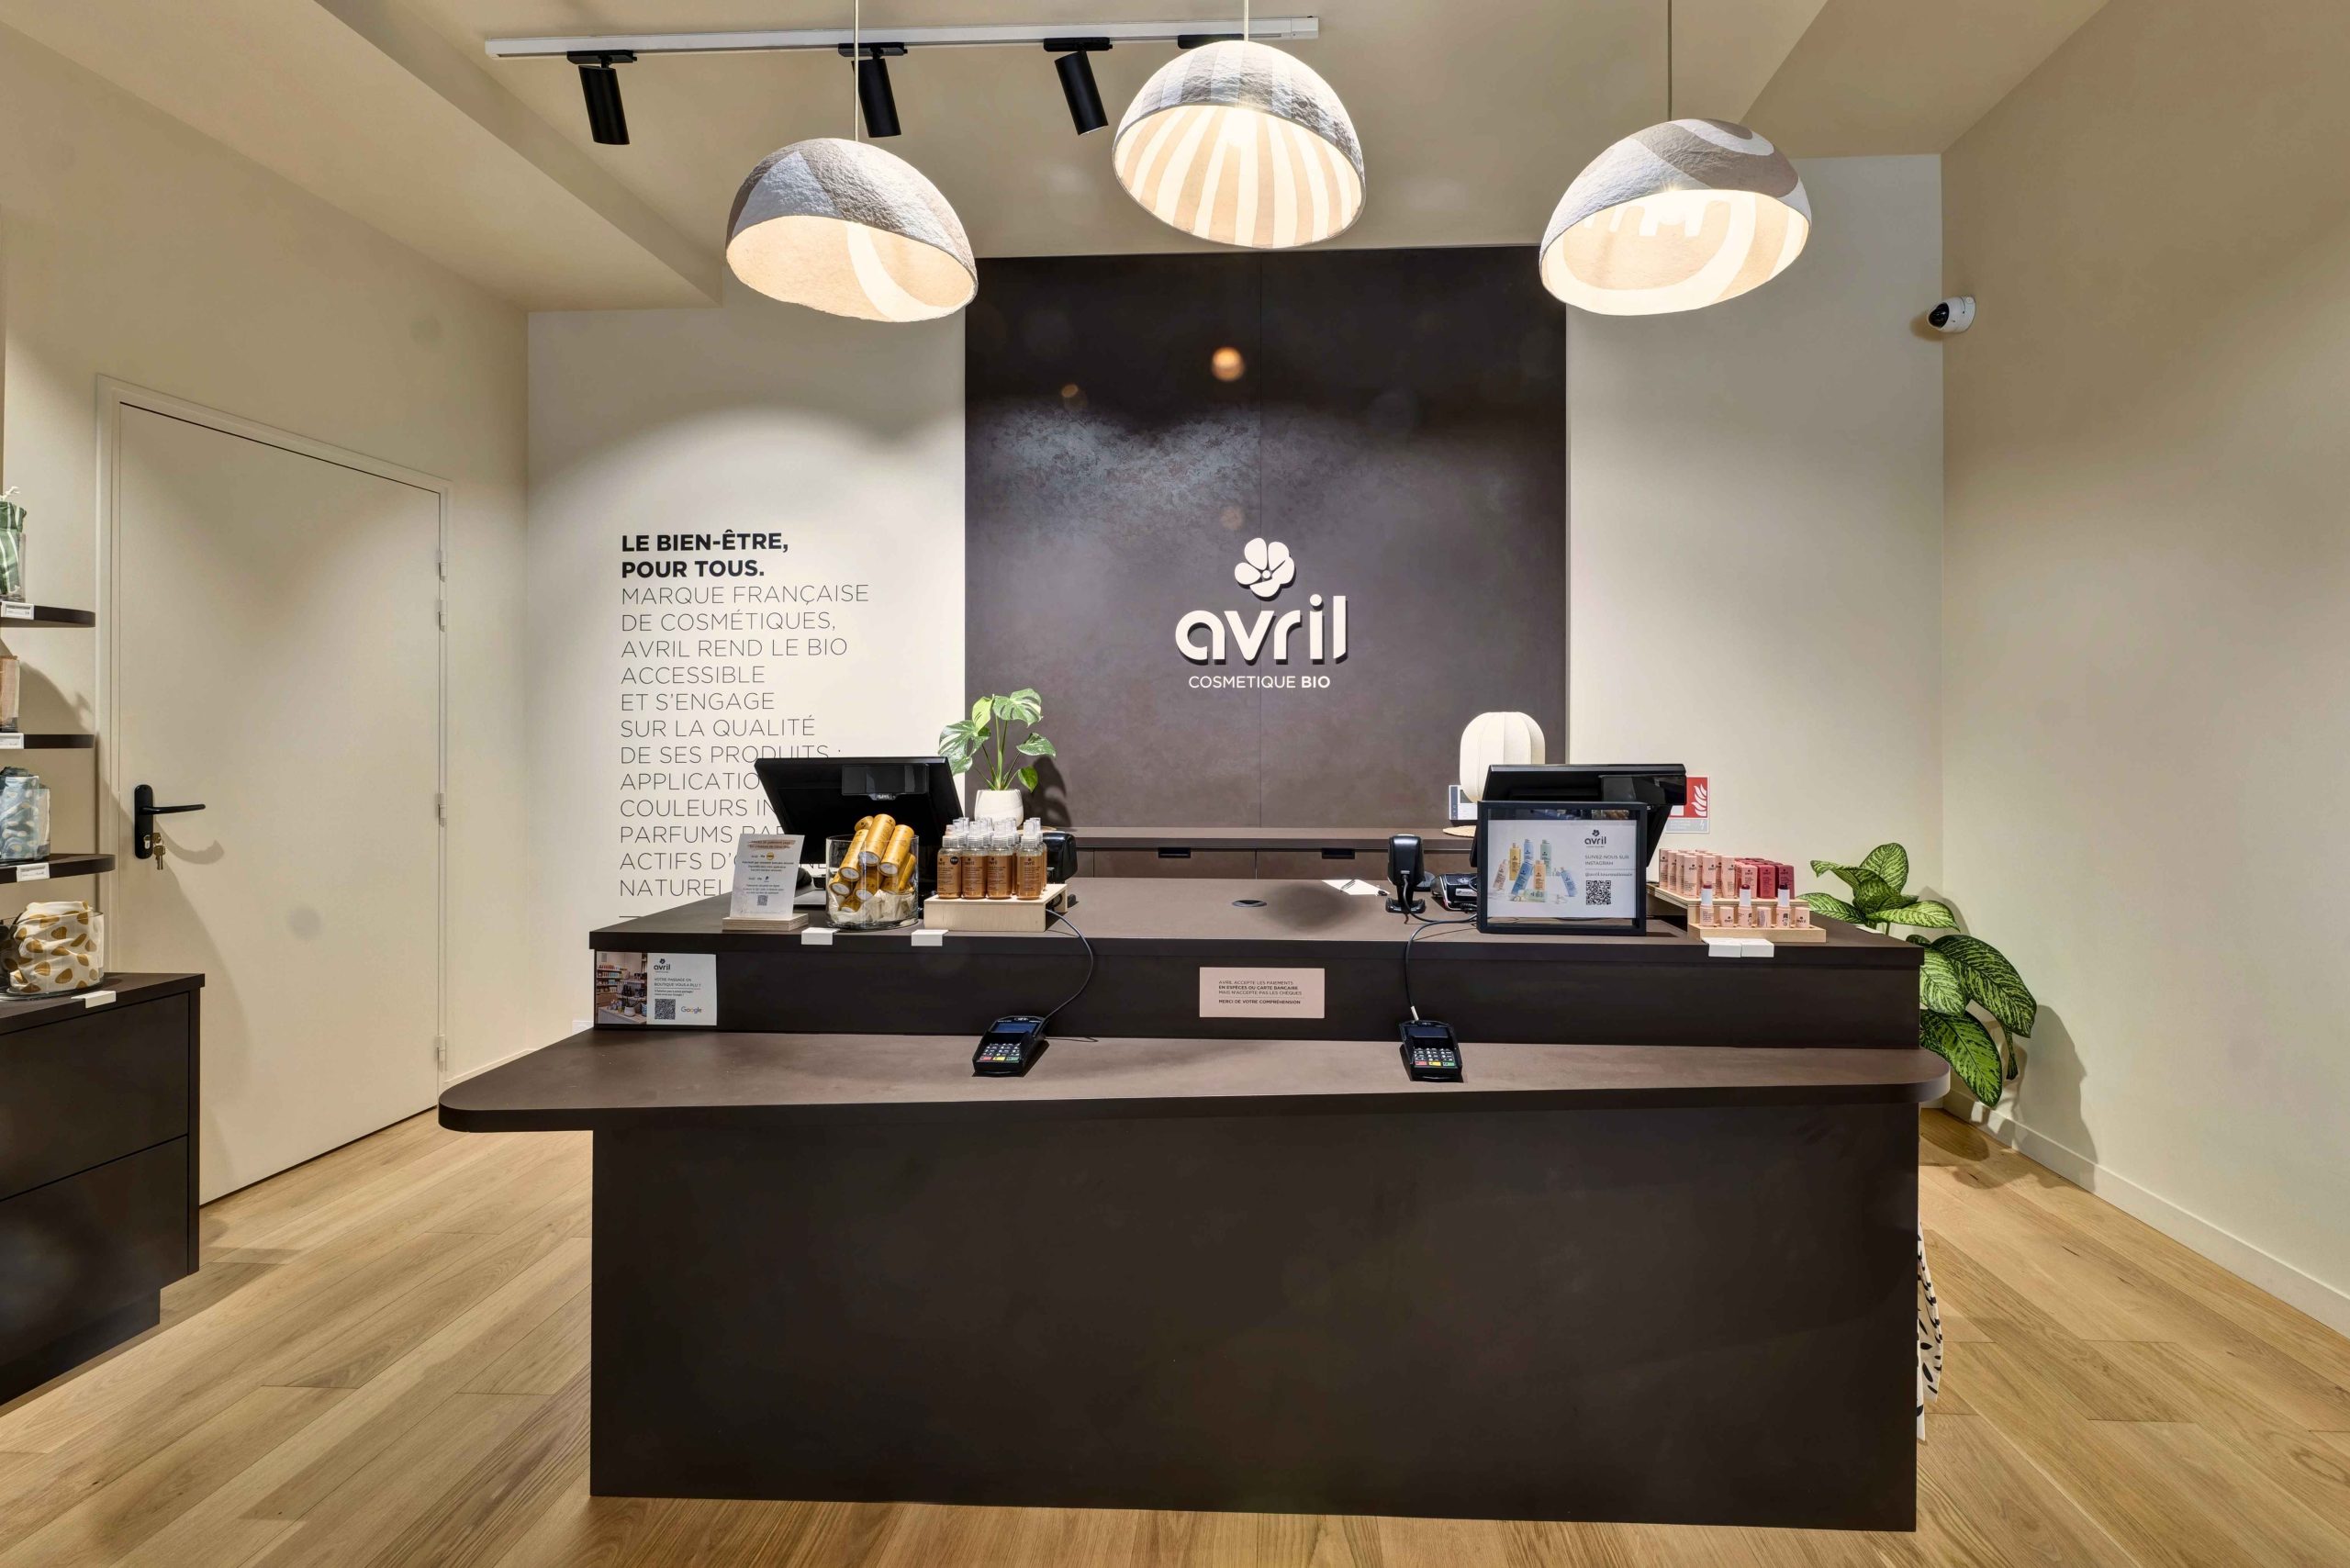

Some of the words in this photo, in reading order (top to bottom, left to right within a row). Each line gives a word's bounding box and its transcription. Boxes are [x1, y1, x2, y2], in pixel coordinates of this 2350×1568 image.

[621, 534, 650, 552] LE
[656, 529, 789, 553] BIEN-ÊTRE,
[621, 561, 688, 578] POUR
[695, 559, 765, 577] TOUS.
[621, 587, 725, 605] MARQUE
[733, 584, 869, 606] FRANÇAISE
[621, 613, 652, 632] DE
[661, 610, 836, 631] COSMÉTIQUES,
[1175, 593, 1348, 663] avril
[621, 640, 690, 658] AVRIL
[699, 639, 763, 657] REND
[772, 638, 799, 656] LE
[808, 637, 847, 656] BIO
[621, 666, 765, 685] ACCESSIBLE
[1188, 676, 1296, 689] COSMETIQUE
[1301, 676, 1331, 689] BIO
[621, 693, 648, 711] ET
[655, 692, 775, 711] S'ENGAGE
[621, 720, 666, 738] SUR
[676, 719, 705, 737] LA
[712, 714, 815, 737] QUALITÉ
[621, 746, 651, 764] DE
[660, 745, 701, 764] SES
[620, 772, 761, 790] APPLICATIO
[620, 799, 748, 817] COULEURS
[621, 825, 733, 844] PARFUMS
[1584, 836, 1606, 845] avril
[620, 852, 702, 869] ACTIFS
[680, 1005, 702, 1014] Google
